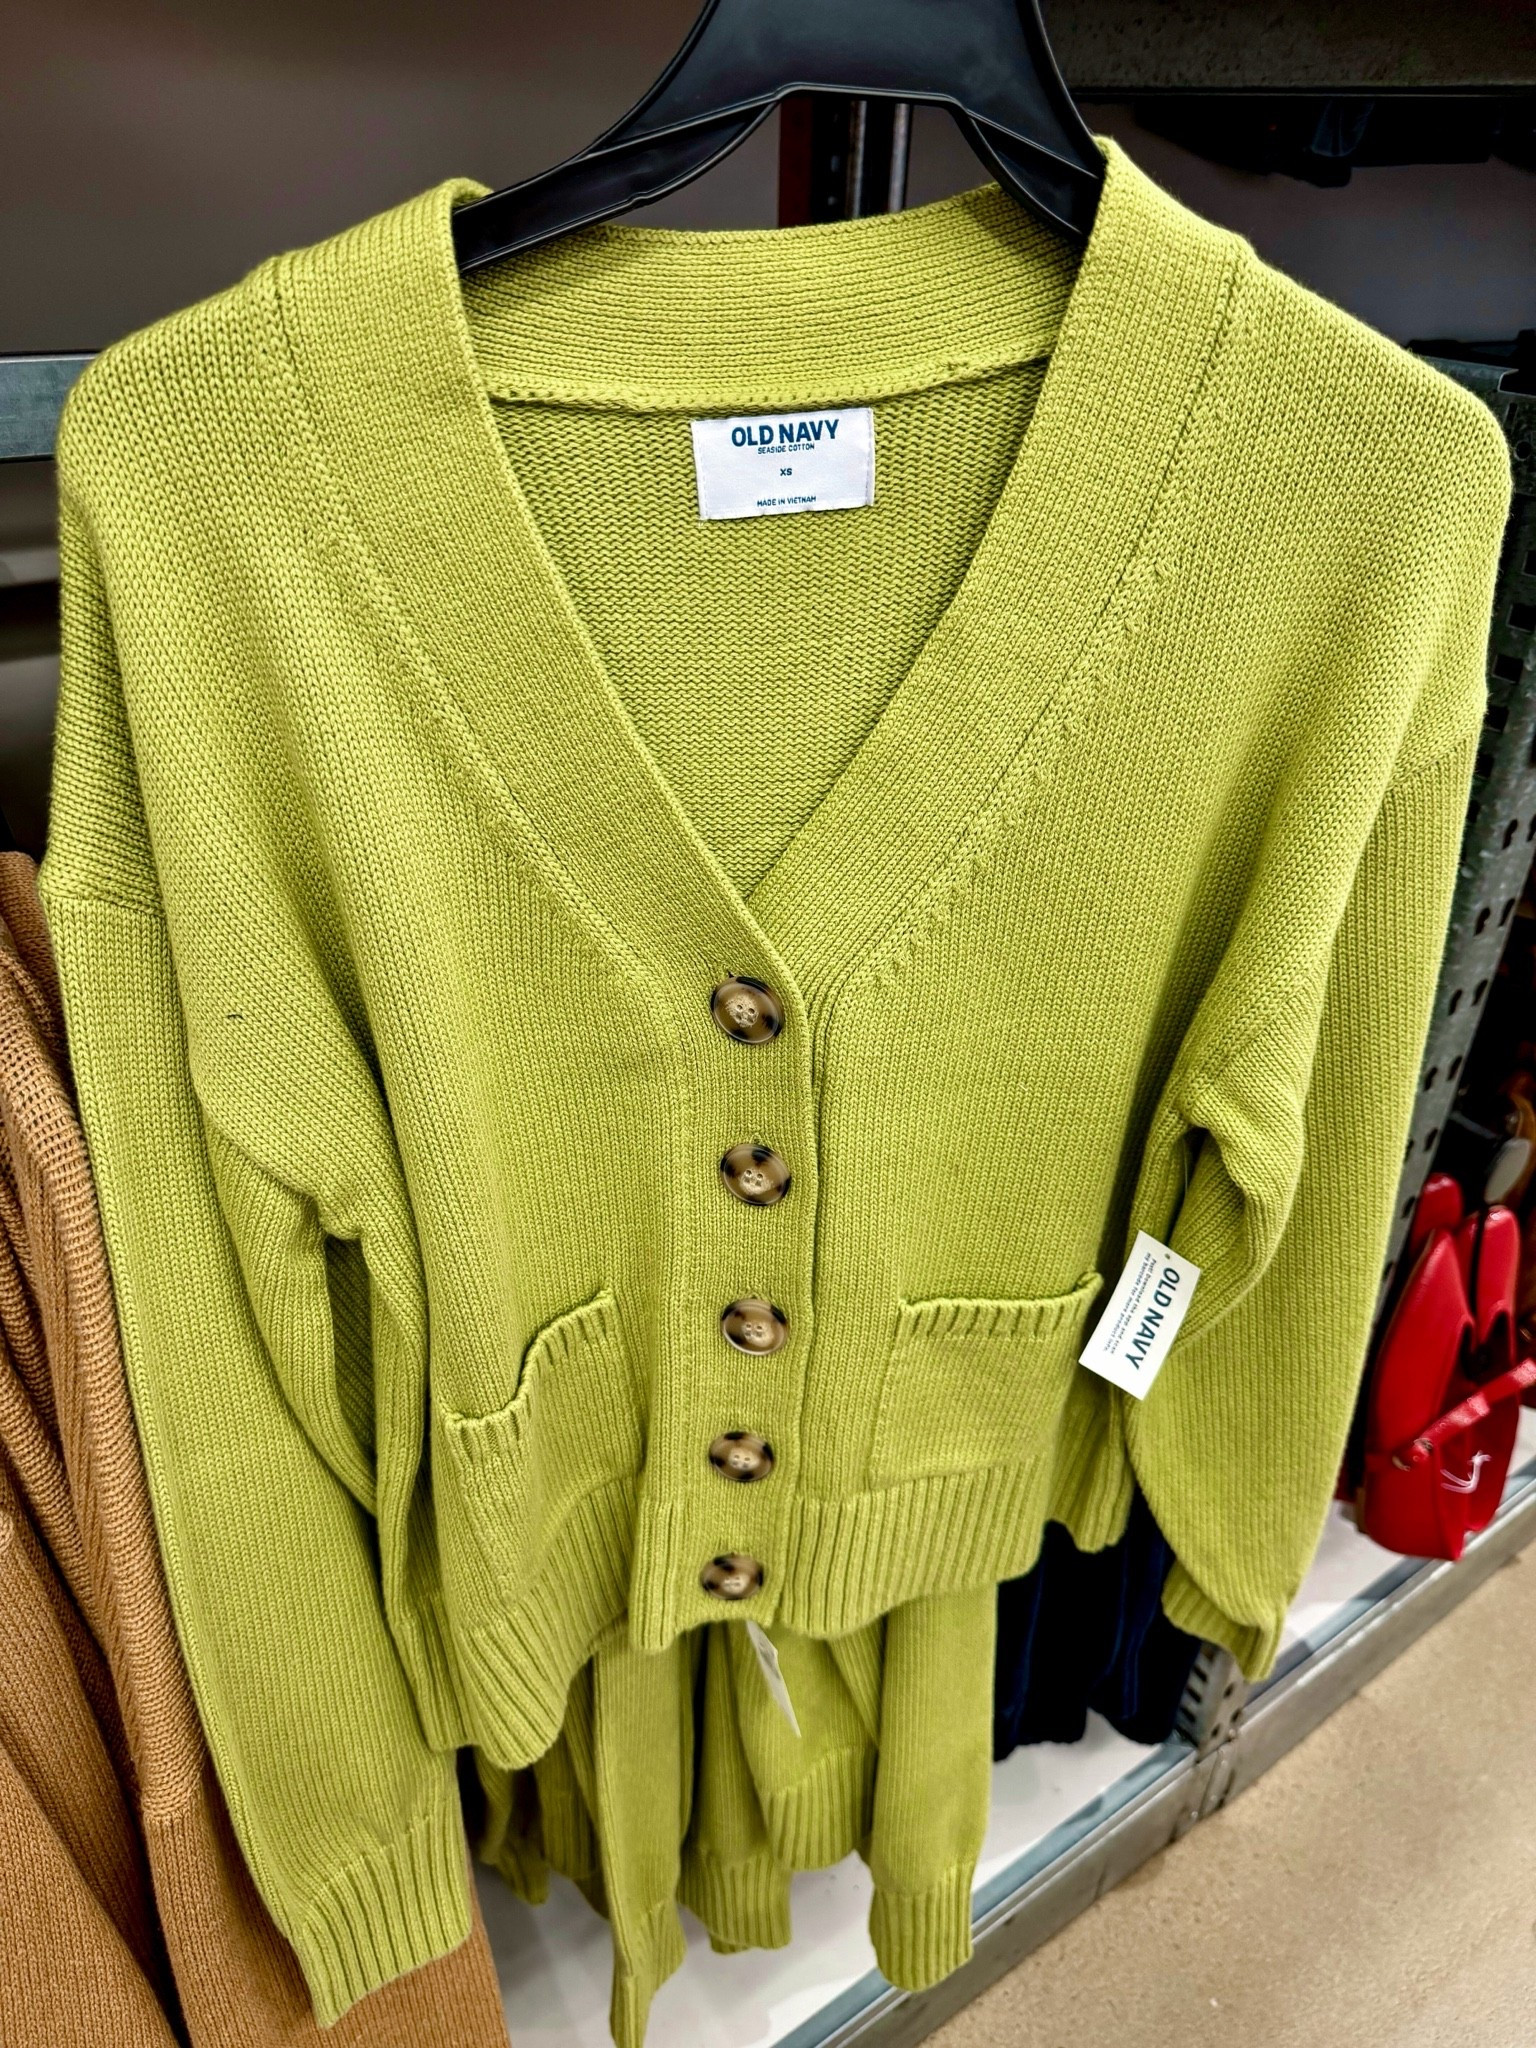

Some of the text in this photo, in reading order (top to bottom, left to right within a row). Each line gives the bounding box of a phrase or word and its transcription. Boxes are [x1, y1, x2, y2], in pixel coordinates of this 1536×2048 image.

[732, 419, 839, 447] OLD NAVY
[758, 443, 815, 454] SEASIDE COTTON
[780, 468, 792, 476] XS
[757, 495, 816, 507] MADE IN VIETNAM
[1125, 1267, 1180, 1370] OLD NAVY
